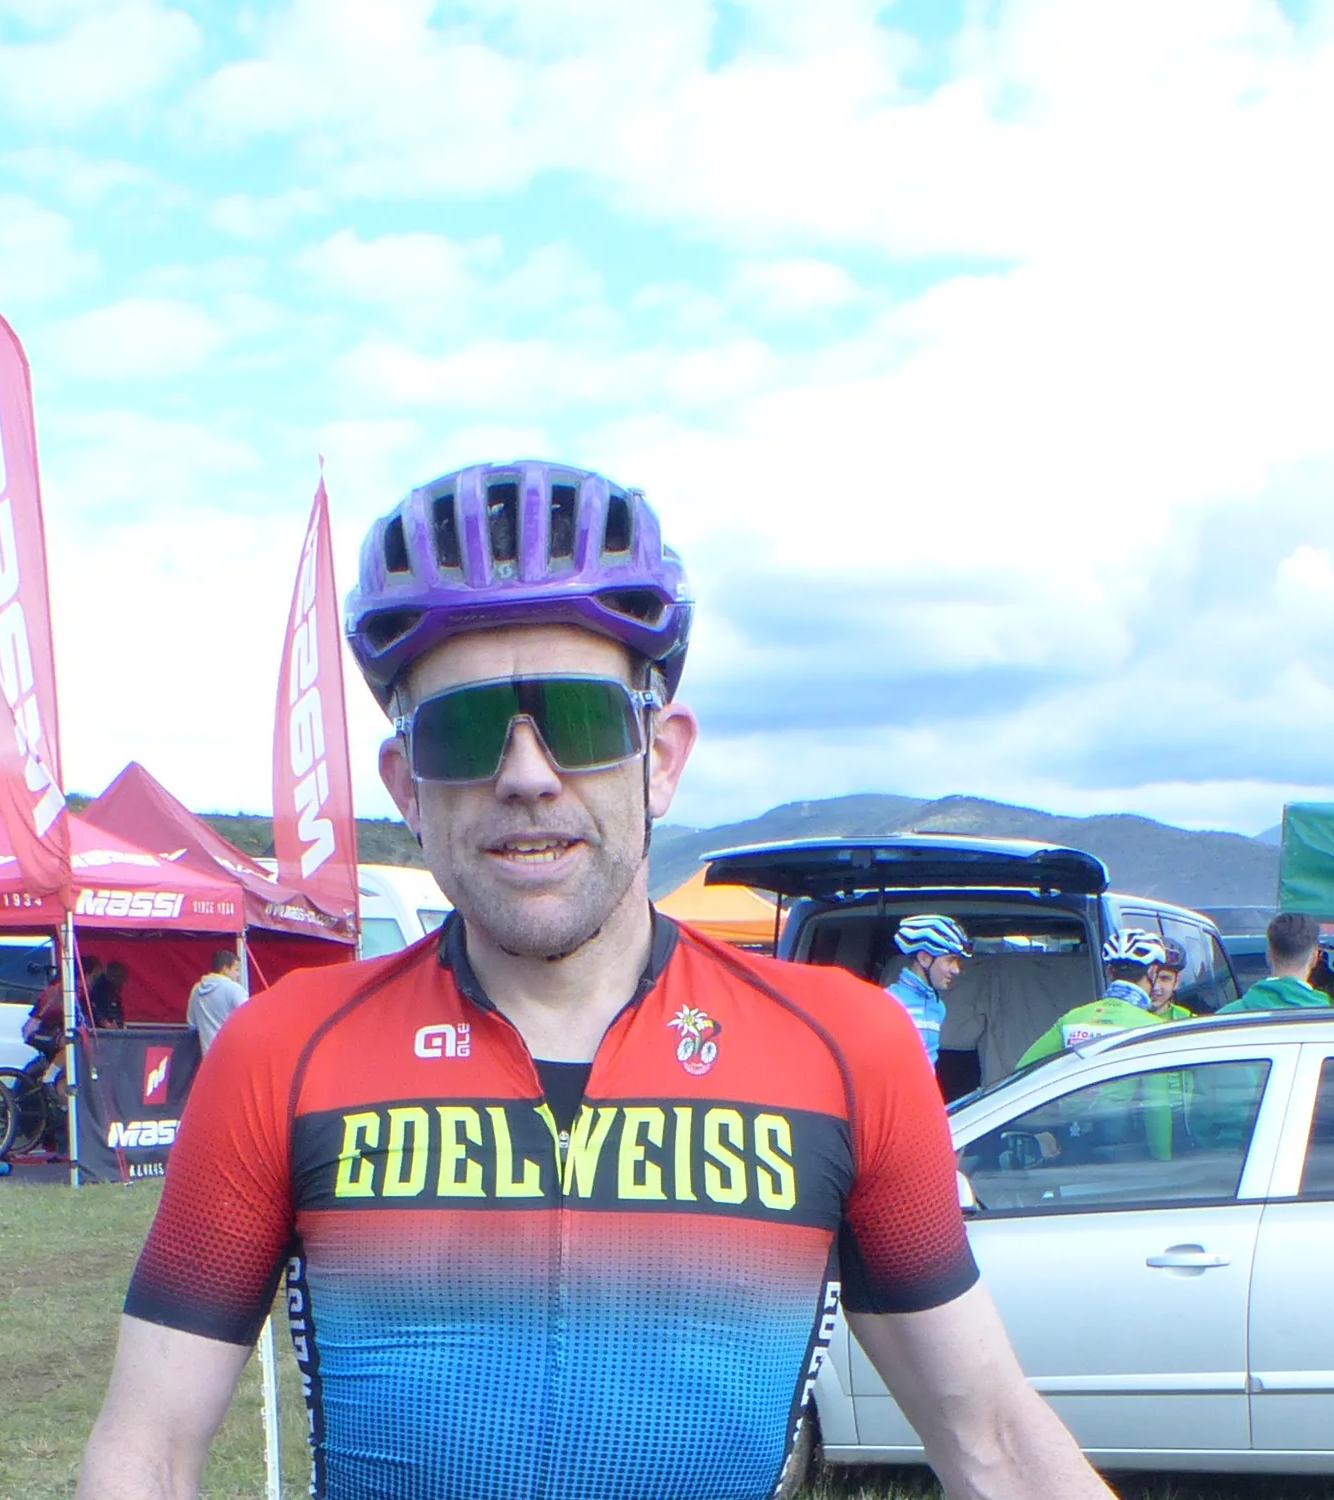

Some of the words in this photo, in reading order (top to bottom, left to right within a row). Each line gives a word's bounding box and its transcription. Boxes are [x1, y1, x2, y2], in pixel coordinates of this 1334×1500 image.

[76, 889, 186, 918] MASSI
[108, 1120, 180, 1148] MAS
[334, 1102, 797, 1212] EDELWEISS
